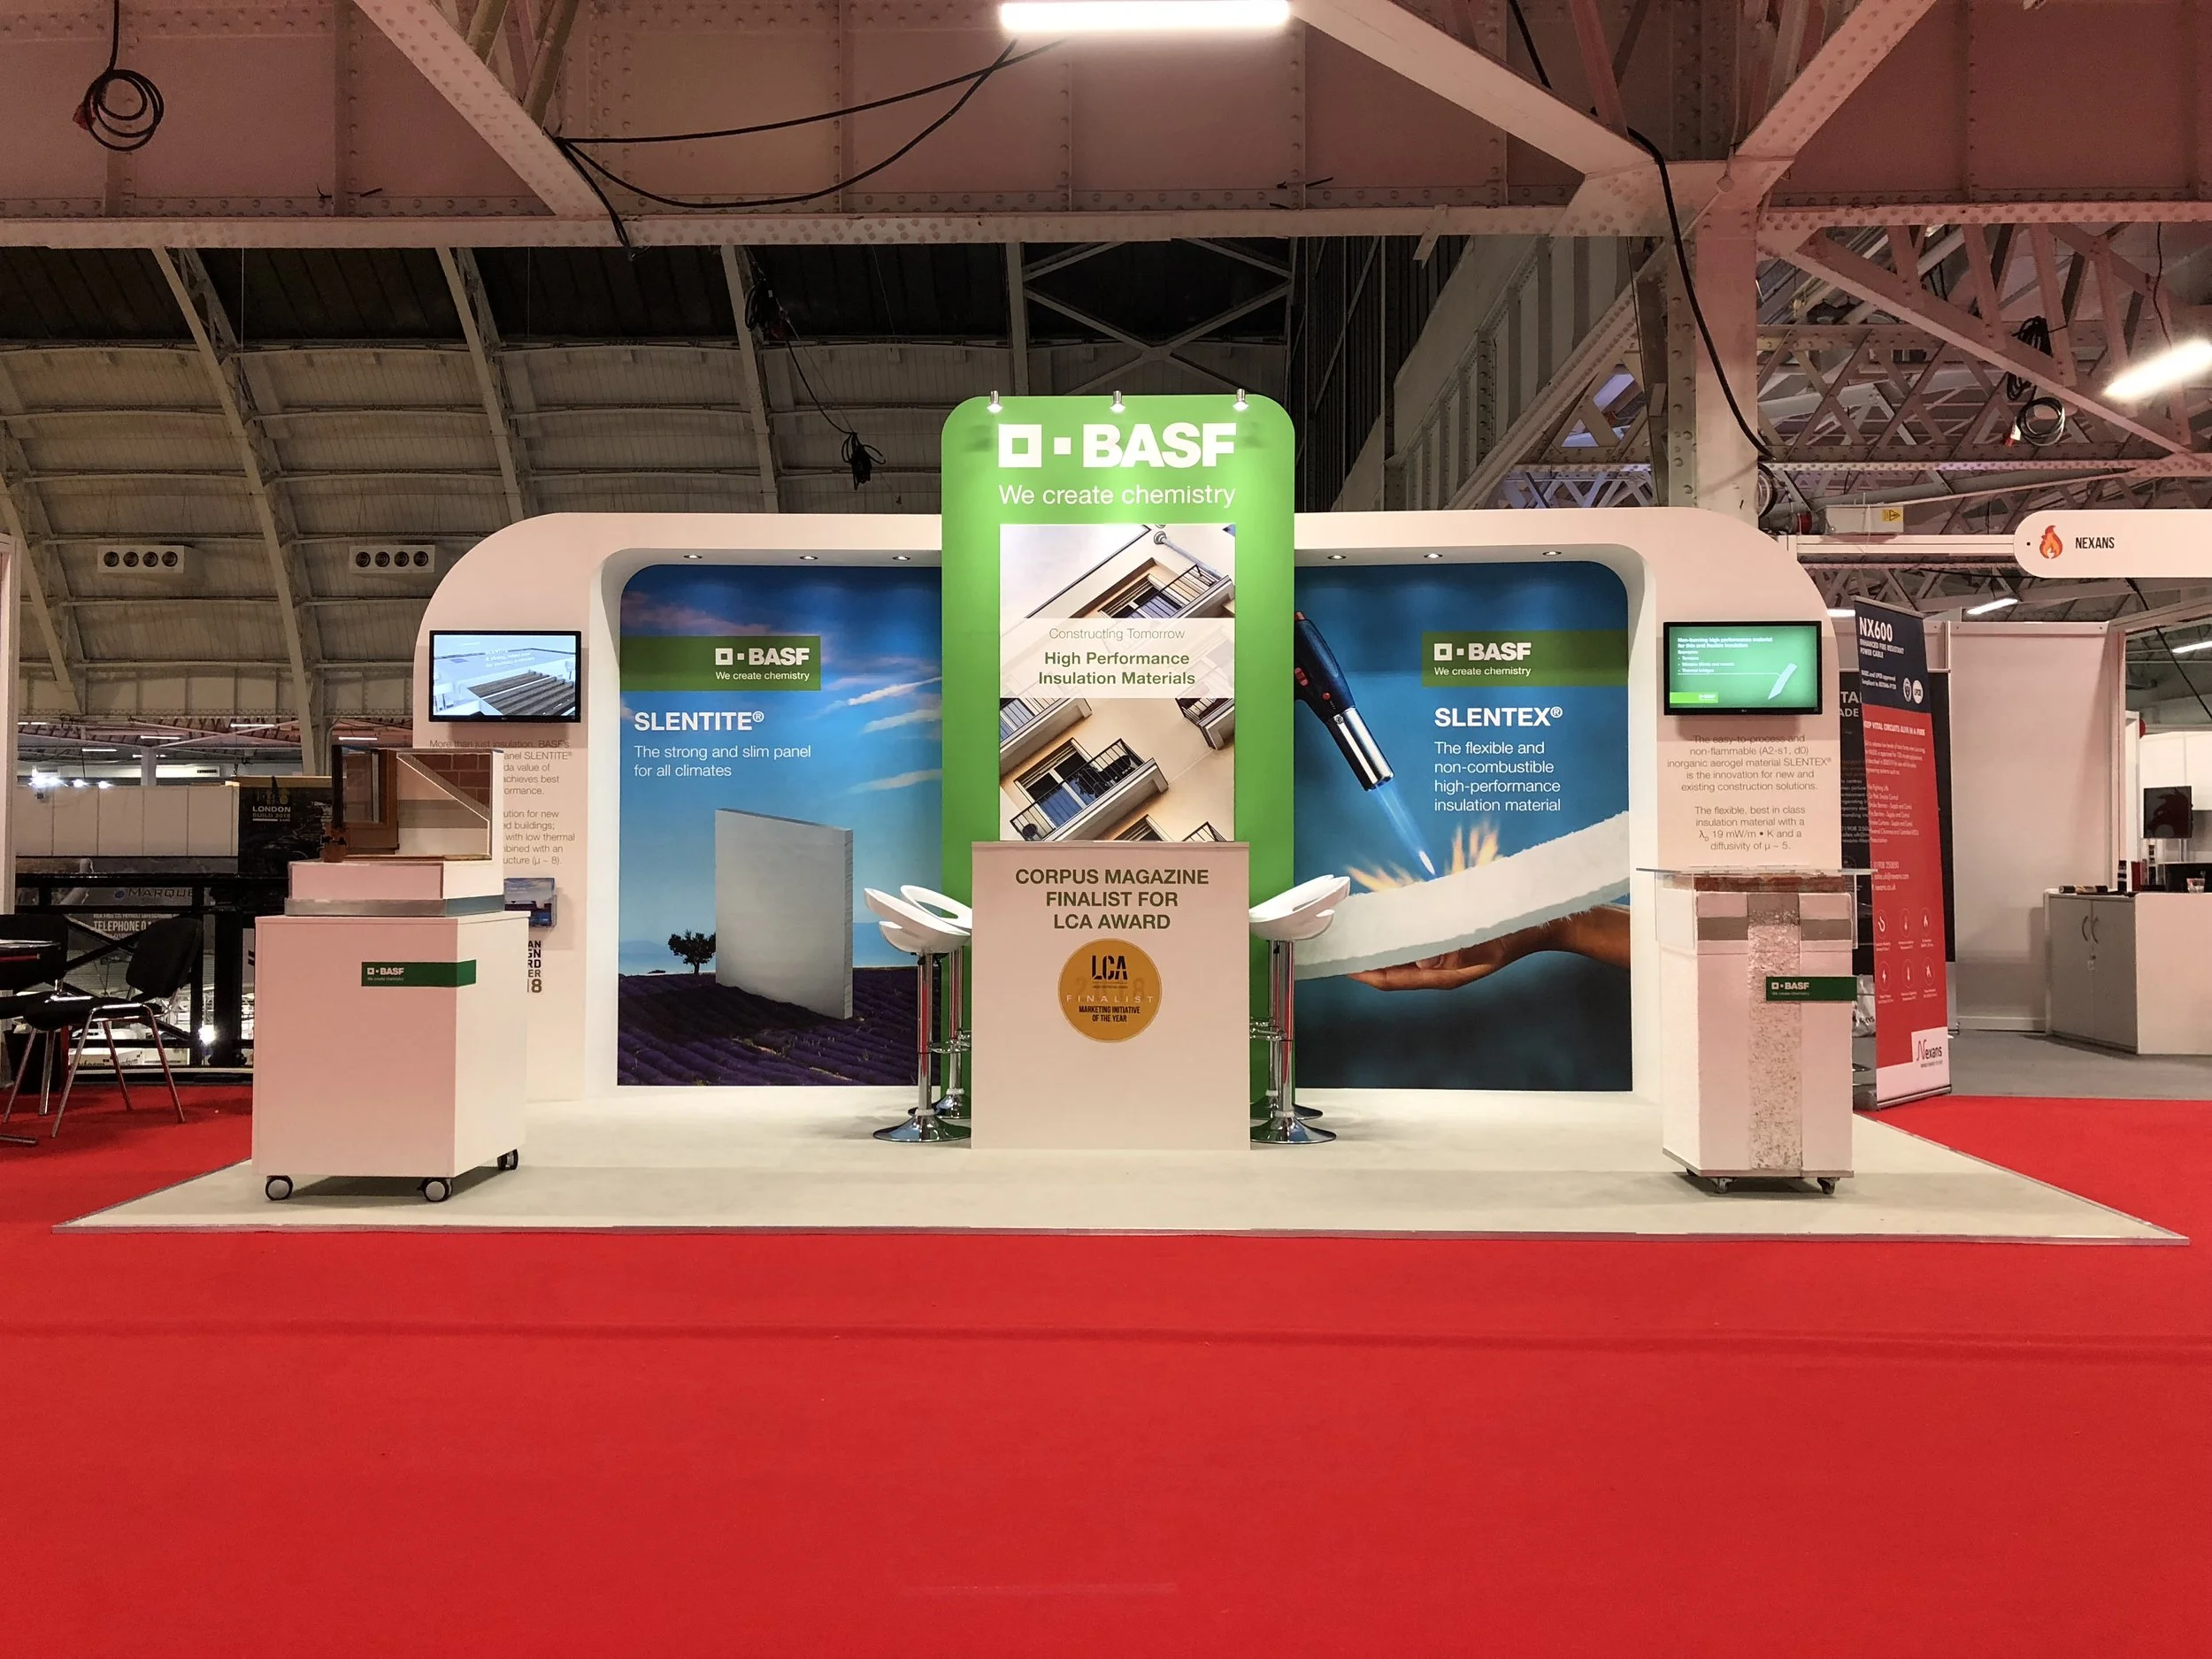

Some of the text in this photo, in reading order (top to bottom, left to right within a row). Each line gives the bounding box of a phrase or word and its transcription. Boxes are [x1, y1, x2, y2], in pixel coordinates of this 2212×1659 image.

[1083, 422, 1237, 468] BASF
[999, 484, 1236, 508] We create chemistry
[2076, 537, 2115, 549] NEXANS
[1048, 628, 1186, 641] Constructing Tomorrow
[1859, 617, 1893, 642] NX600
[749, 648, 810, 666] BASF
[1469, 642, 1532, 661] BASF
[1044, 651, 1189, 667] High Performance
[715, 671, 810, 682] We create chemistry
[1434, 665, 1532, 678] We create chemistry
[1039, 672, 1195, 685] Insulation Materials
[634, 711, 764, 731] SLENTITE®
[1434, 706, 1563, 726] SLENTEX®
[474, 740, 491, 749] just
[1694, 734, 1711, 743] The
[1712, 735, 1786, 745] easy-to-process
[634, 745, 811, 761] The strong and slim panel
[1434, 741, 1545, 755] The flexible and
[1690, 747, 1756, 756] non-flammable
[541, 763, 550, 772] of
[634, 764, 732, 777] for all climates
[1434, 760, 1554, 774] non-combustible
[1667, 759, 1708, 769] inorganic
[1710, 759, 1743, 769] aerogel
[1434, 780, 1561, 795] high-performance
[1681, 781, 1817, 792] existing construction solutions.
[1434, 798, 1561, 812] insulation material
[1694, 806, 1711, 815] The
[1715, 806, 1747, 816] flexible,
[1750, 806, 1770, 815] best
[514, 822, 556, 832] buildings;
[1778, 818, 1796, 826] with
[1710, 841, 1750, 851] diffusivity
[1754, 841, 1763, 850] of
[551, 856, 563, 865] 8).
[1015, 869, 1209, 885] CORPUS MAGAZINE
[1046, 891, 1178, 907] FINALIST FOR
[93, 920, 139, 932] TELEPHONE
[1054, 913, 1171, 929] LCA AWARD
[1092, 956, 1128, 979] LCA
[1066, 995, 1154, 1003] FINALIST
[1079, 1005, 1111, 1014] MARKETING
[1916, 1039, 1943, 1061] Nexans
